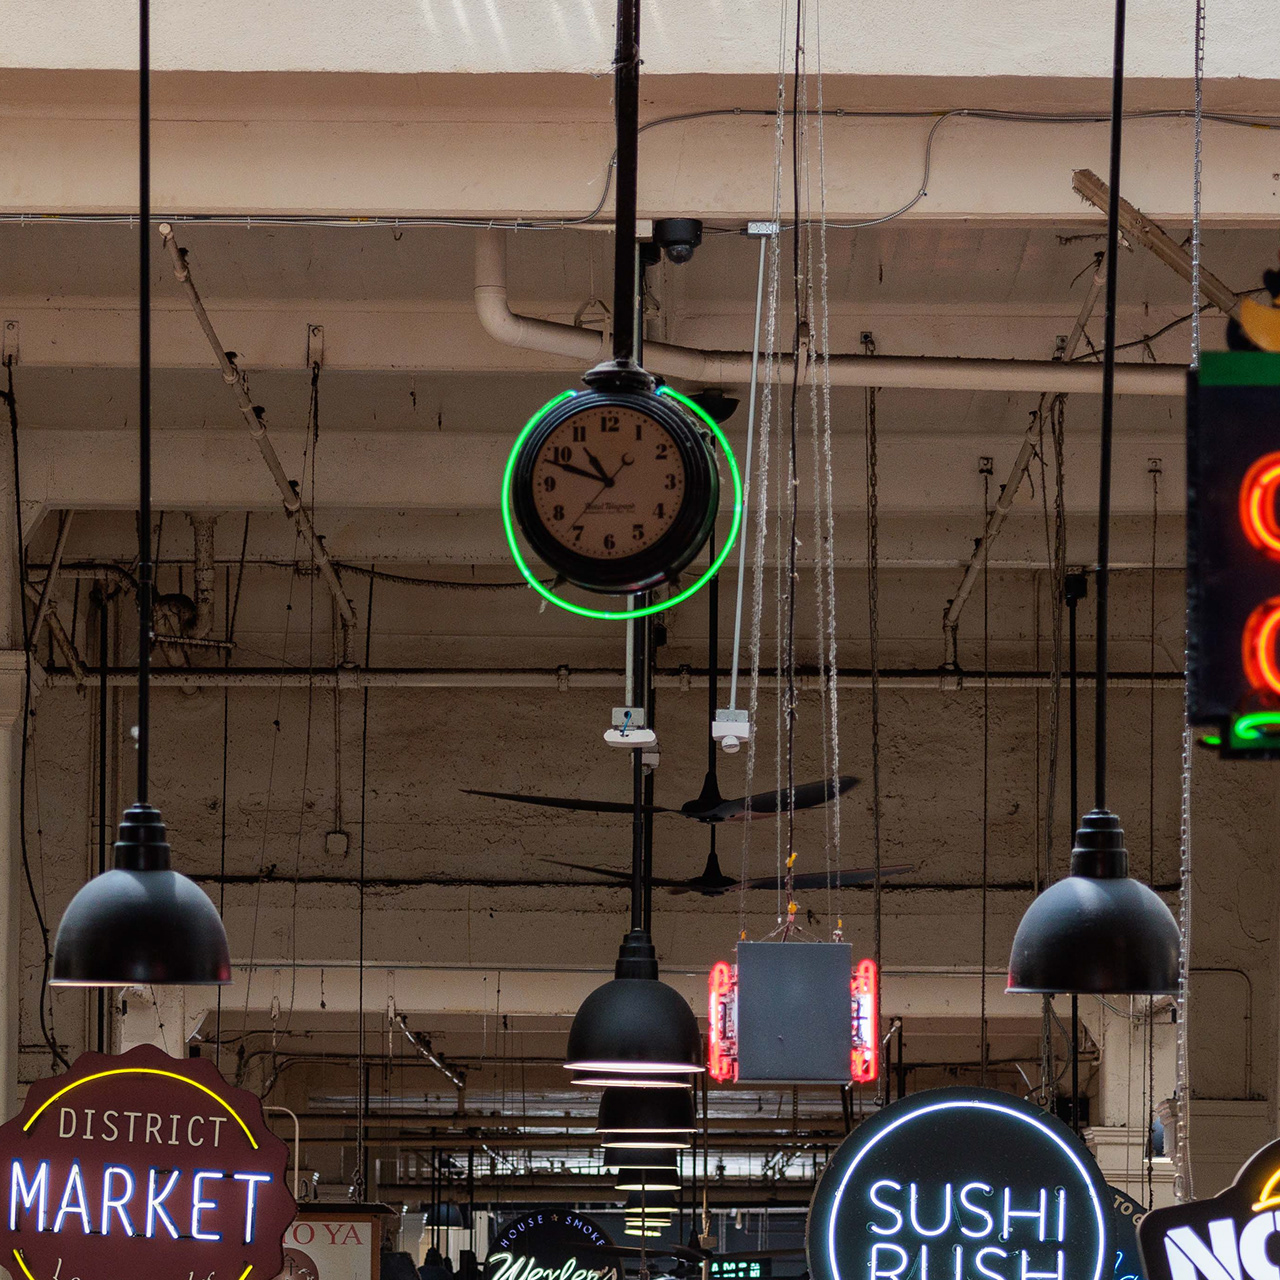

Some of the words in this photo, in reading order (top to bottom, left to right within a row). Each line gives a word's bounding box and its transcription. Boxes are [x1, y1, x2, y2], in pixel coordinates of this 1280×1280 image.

[601, 416, 619, 432] 12
[573, 426, 586, 442] 11
[635, 425, 642, 441] 1
[553, 446, 572, 462] 10
[655, 443, 667, 459] 2
[544, 476, 556, 492] 9
[664, 474, 676, 490] 3
[553, 505, 565, 521] 8
[652, 503, 666, 519] 4
[572, 525, 584, 541] 7
[632, 524, 644, 540] 5
[604, 534, 615, 550] 6
[59, 1107, 227, 1147] DISTRICT
[8, 1158, 273, 1243] MARKET
[1113, 1194, 1133, 1216] TO
[869, 1180, 1066, 1243] SUSHI
[321, 1223, 363, 1246] YA
[500, 1214, 544, 1248] HOUSE
[565, 1216, 606, 1247] SMOKE
